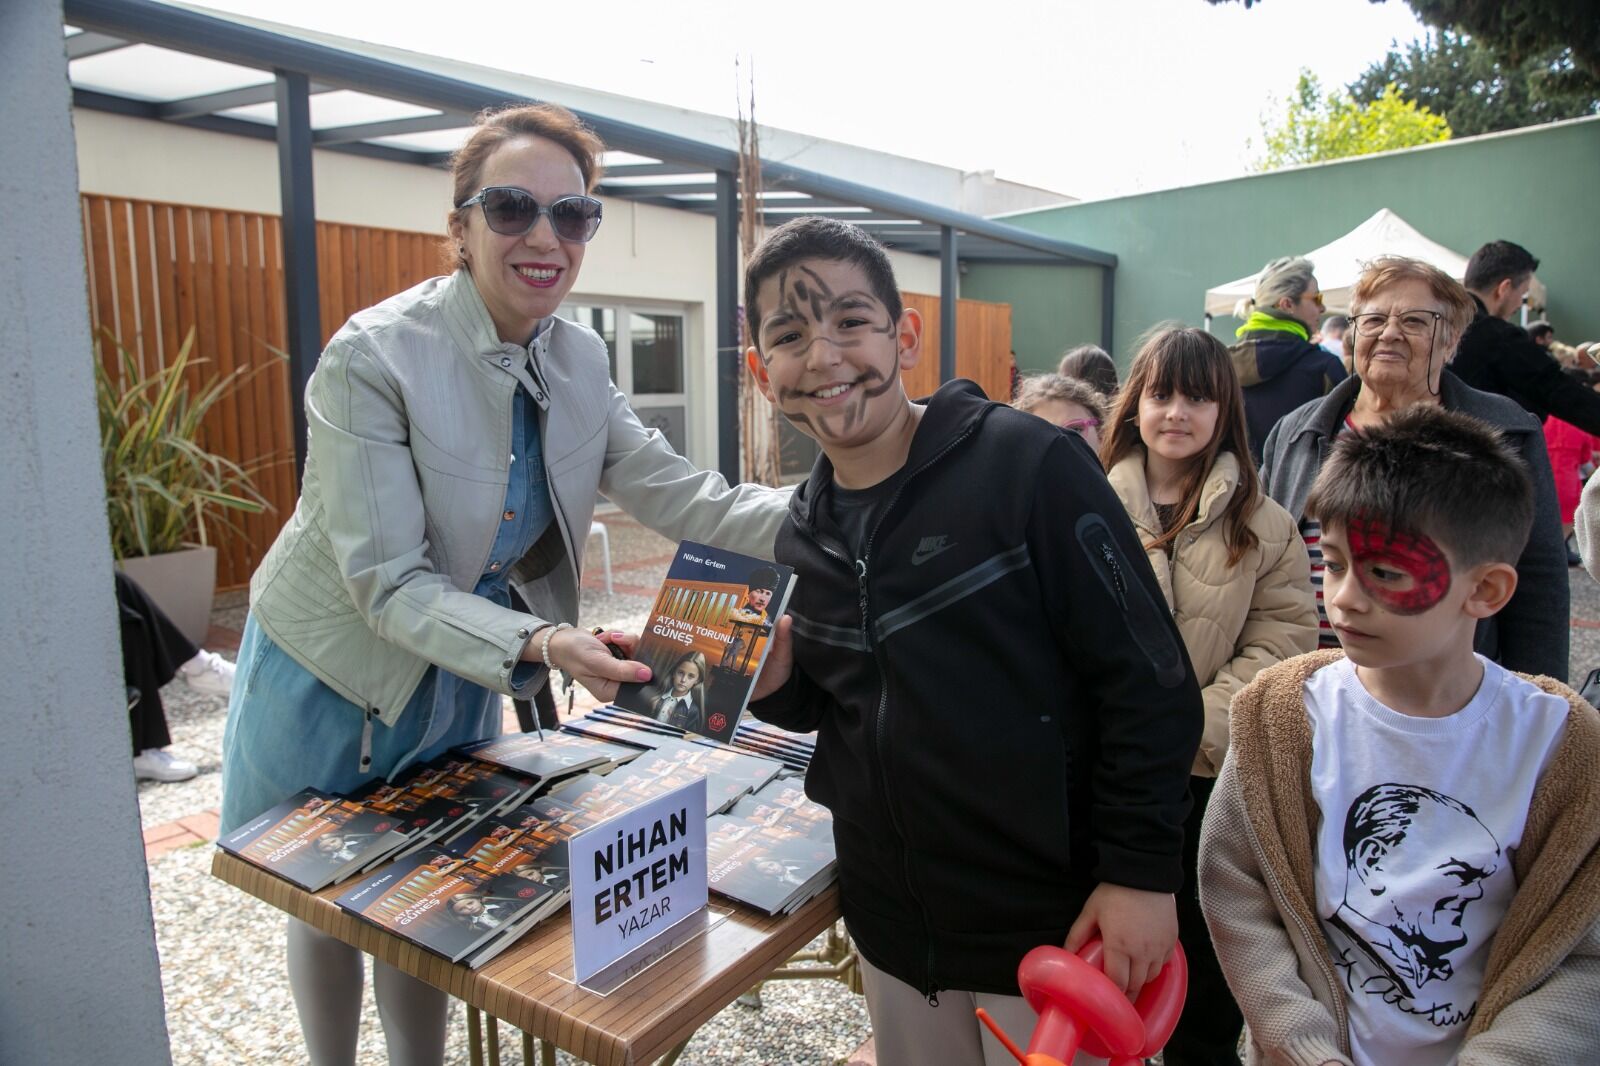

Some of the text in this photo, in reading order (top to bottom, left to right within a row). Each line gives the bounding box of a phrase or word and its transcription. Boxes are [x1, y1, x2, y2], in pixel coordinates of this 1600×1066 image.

[917, 534, 948, 552] NIKE
[682, 552, 726, 570] Nihan Ertem
[652, 624, 694, 647] GÜNEŞ
[656, 615, 735, 644] ATA'NIN TORUNU
[594, 808, 687, 881] NİHAN
[493, 846, 525, 870] ORUNU
[371, 874, 393, 888] Ertem
[428, 875, 465, 898] TORUNU
[594, 847, 689, 925] ERTEM
[618, 896, 671, 939] YAZAR
